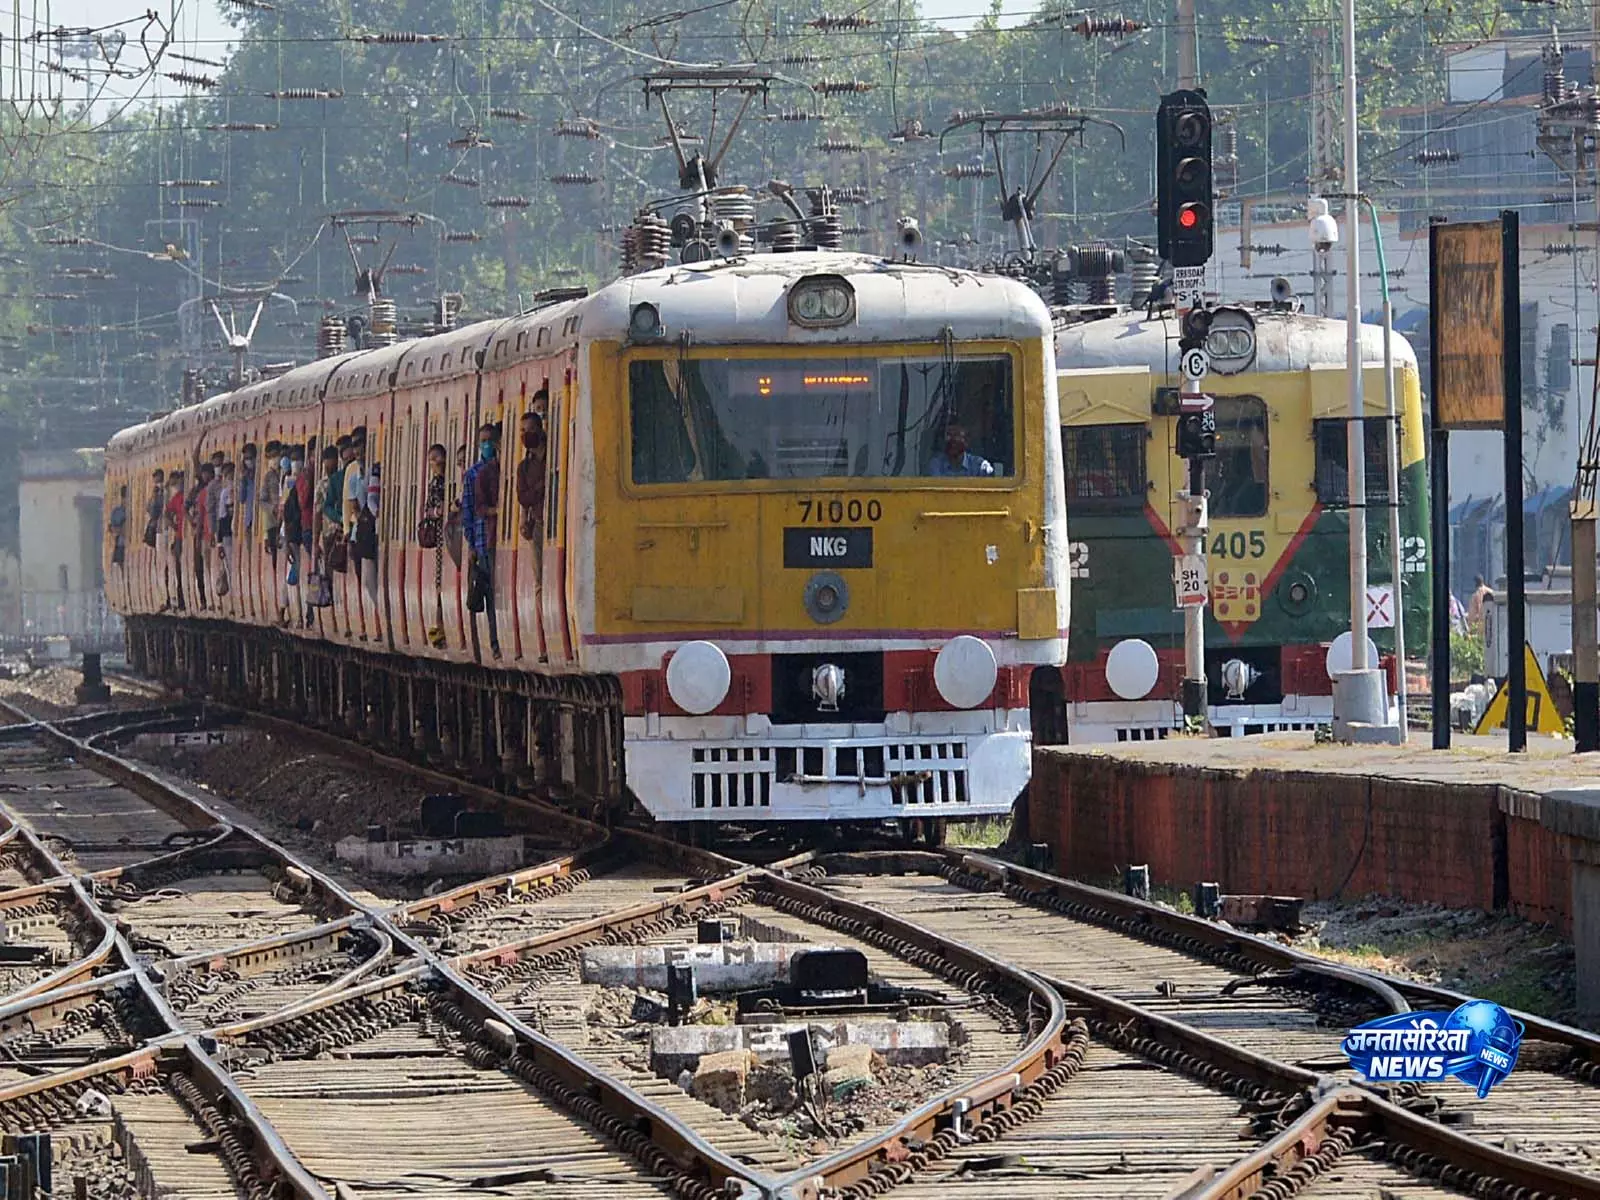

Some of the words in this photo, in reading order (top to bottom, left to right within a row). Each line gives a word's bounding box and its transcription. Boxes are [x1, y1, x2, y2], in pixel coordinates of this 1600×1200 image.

[1203, 410, 1215, 420] SH
[1202, 420, 1216, 431] 20
[798, 500, 882, 523] 71000
[810, 536, 847, 556] NKG
[1182, 570, 1199, 580] SH
[1184, 580, 1200, 592] 20
